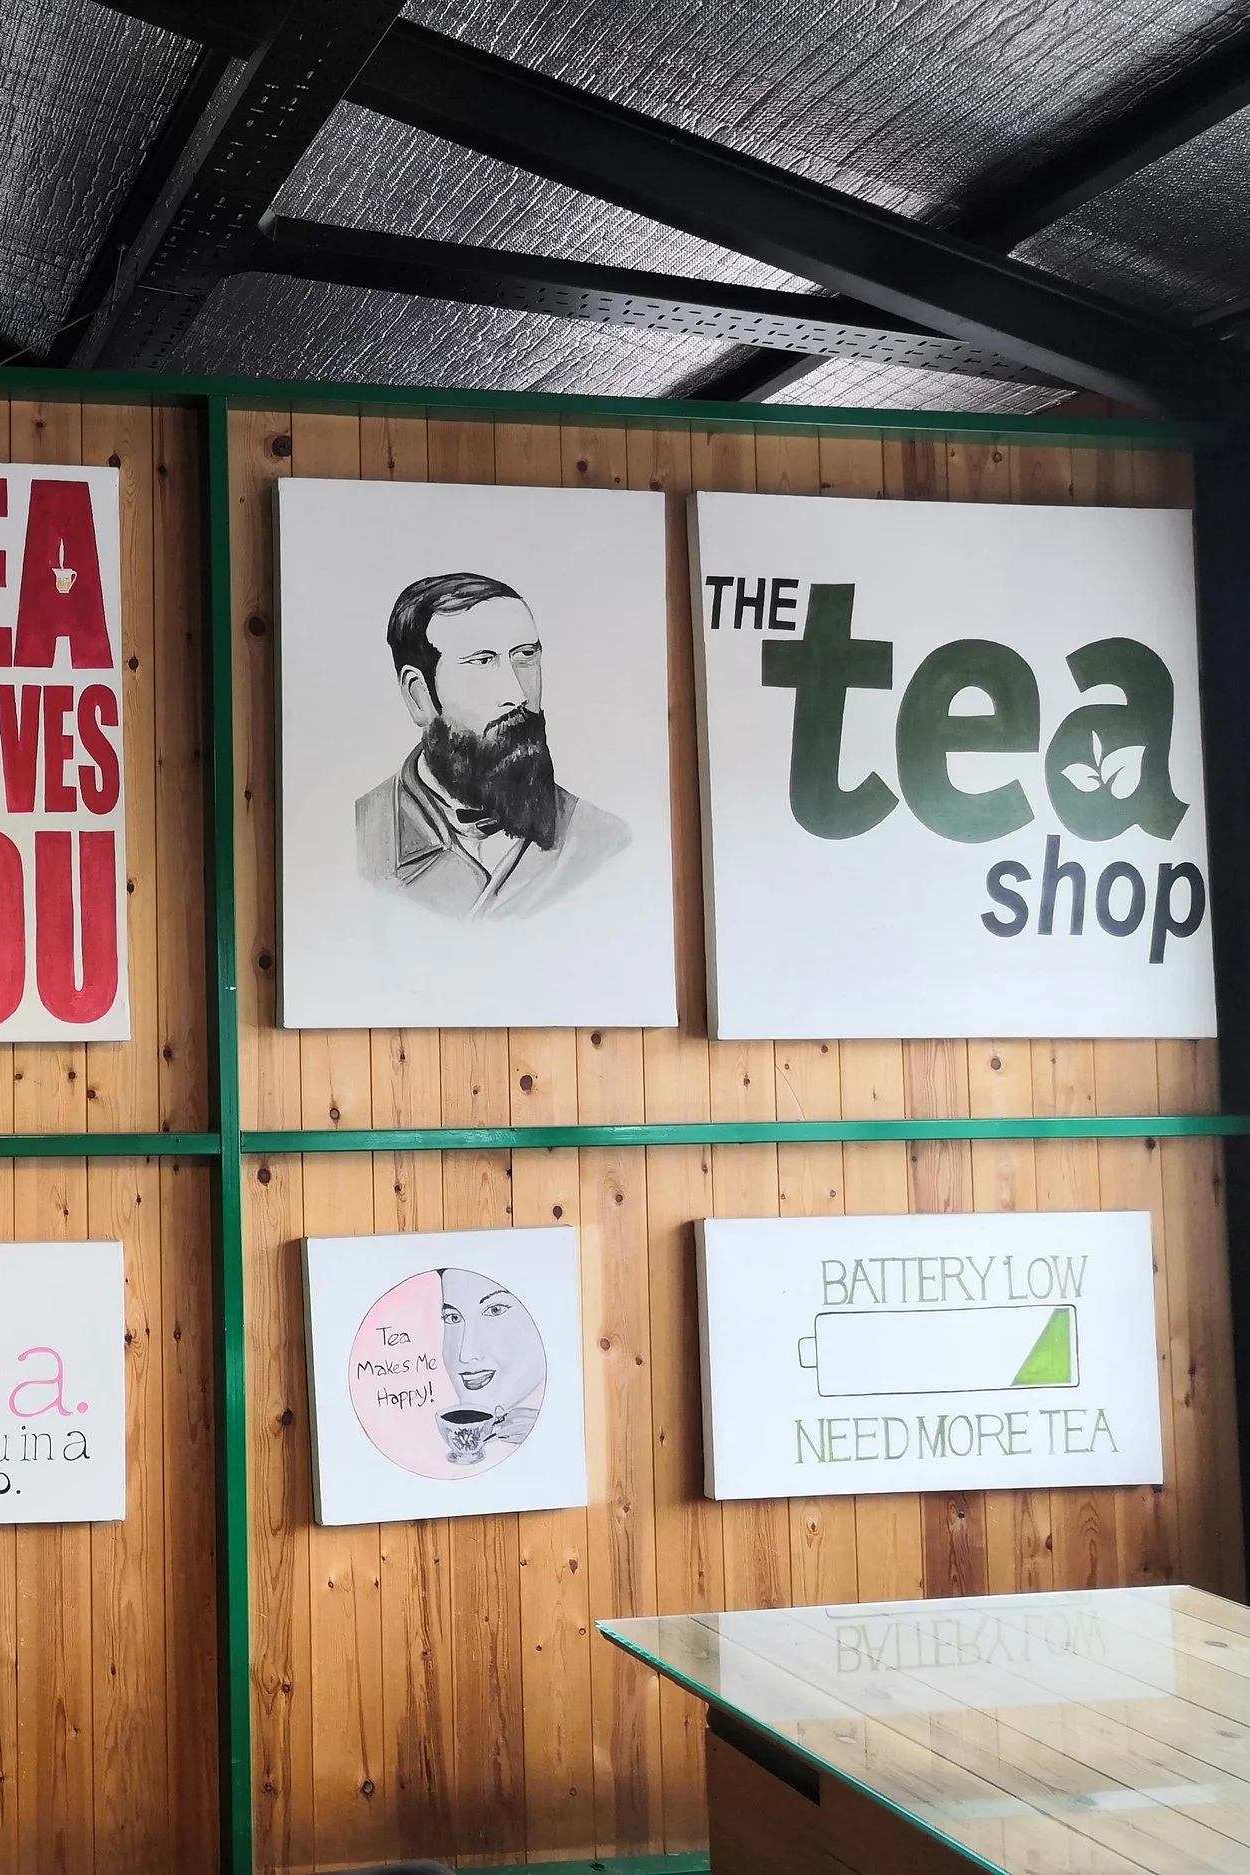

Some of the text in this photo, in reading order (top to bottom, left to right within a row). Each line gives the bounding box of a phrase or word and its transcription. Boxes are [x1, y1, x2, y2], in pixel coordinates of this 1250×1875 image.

[705, 575, 799, 631] THE
[761, 583, 1190, 844] tea
[980, 834, 1206, 965] shop
[821, 1255, 1089, 1306] BATTERY LOW
[376, 1326, 411, 1347] Tea
[357, 1354, 438, 1380] Makes Me
[377, 1381, 435, 1410] Happy!
[20, 1425, 54, 1462] in
[63, 1430, 90, 1461] a
[794, 1408, 1120, 1464] NEED MORE TEA
